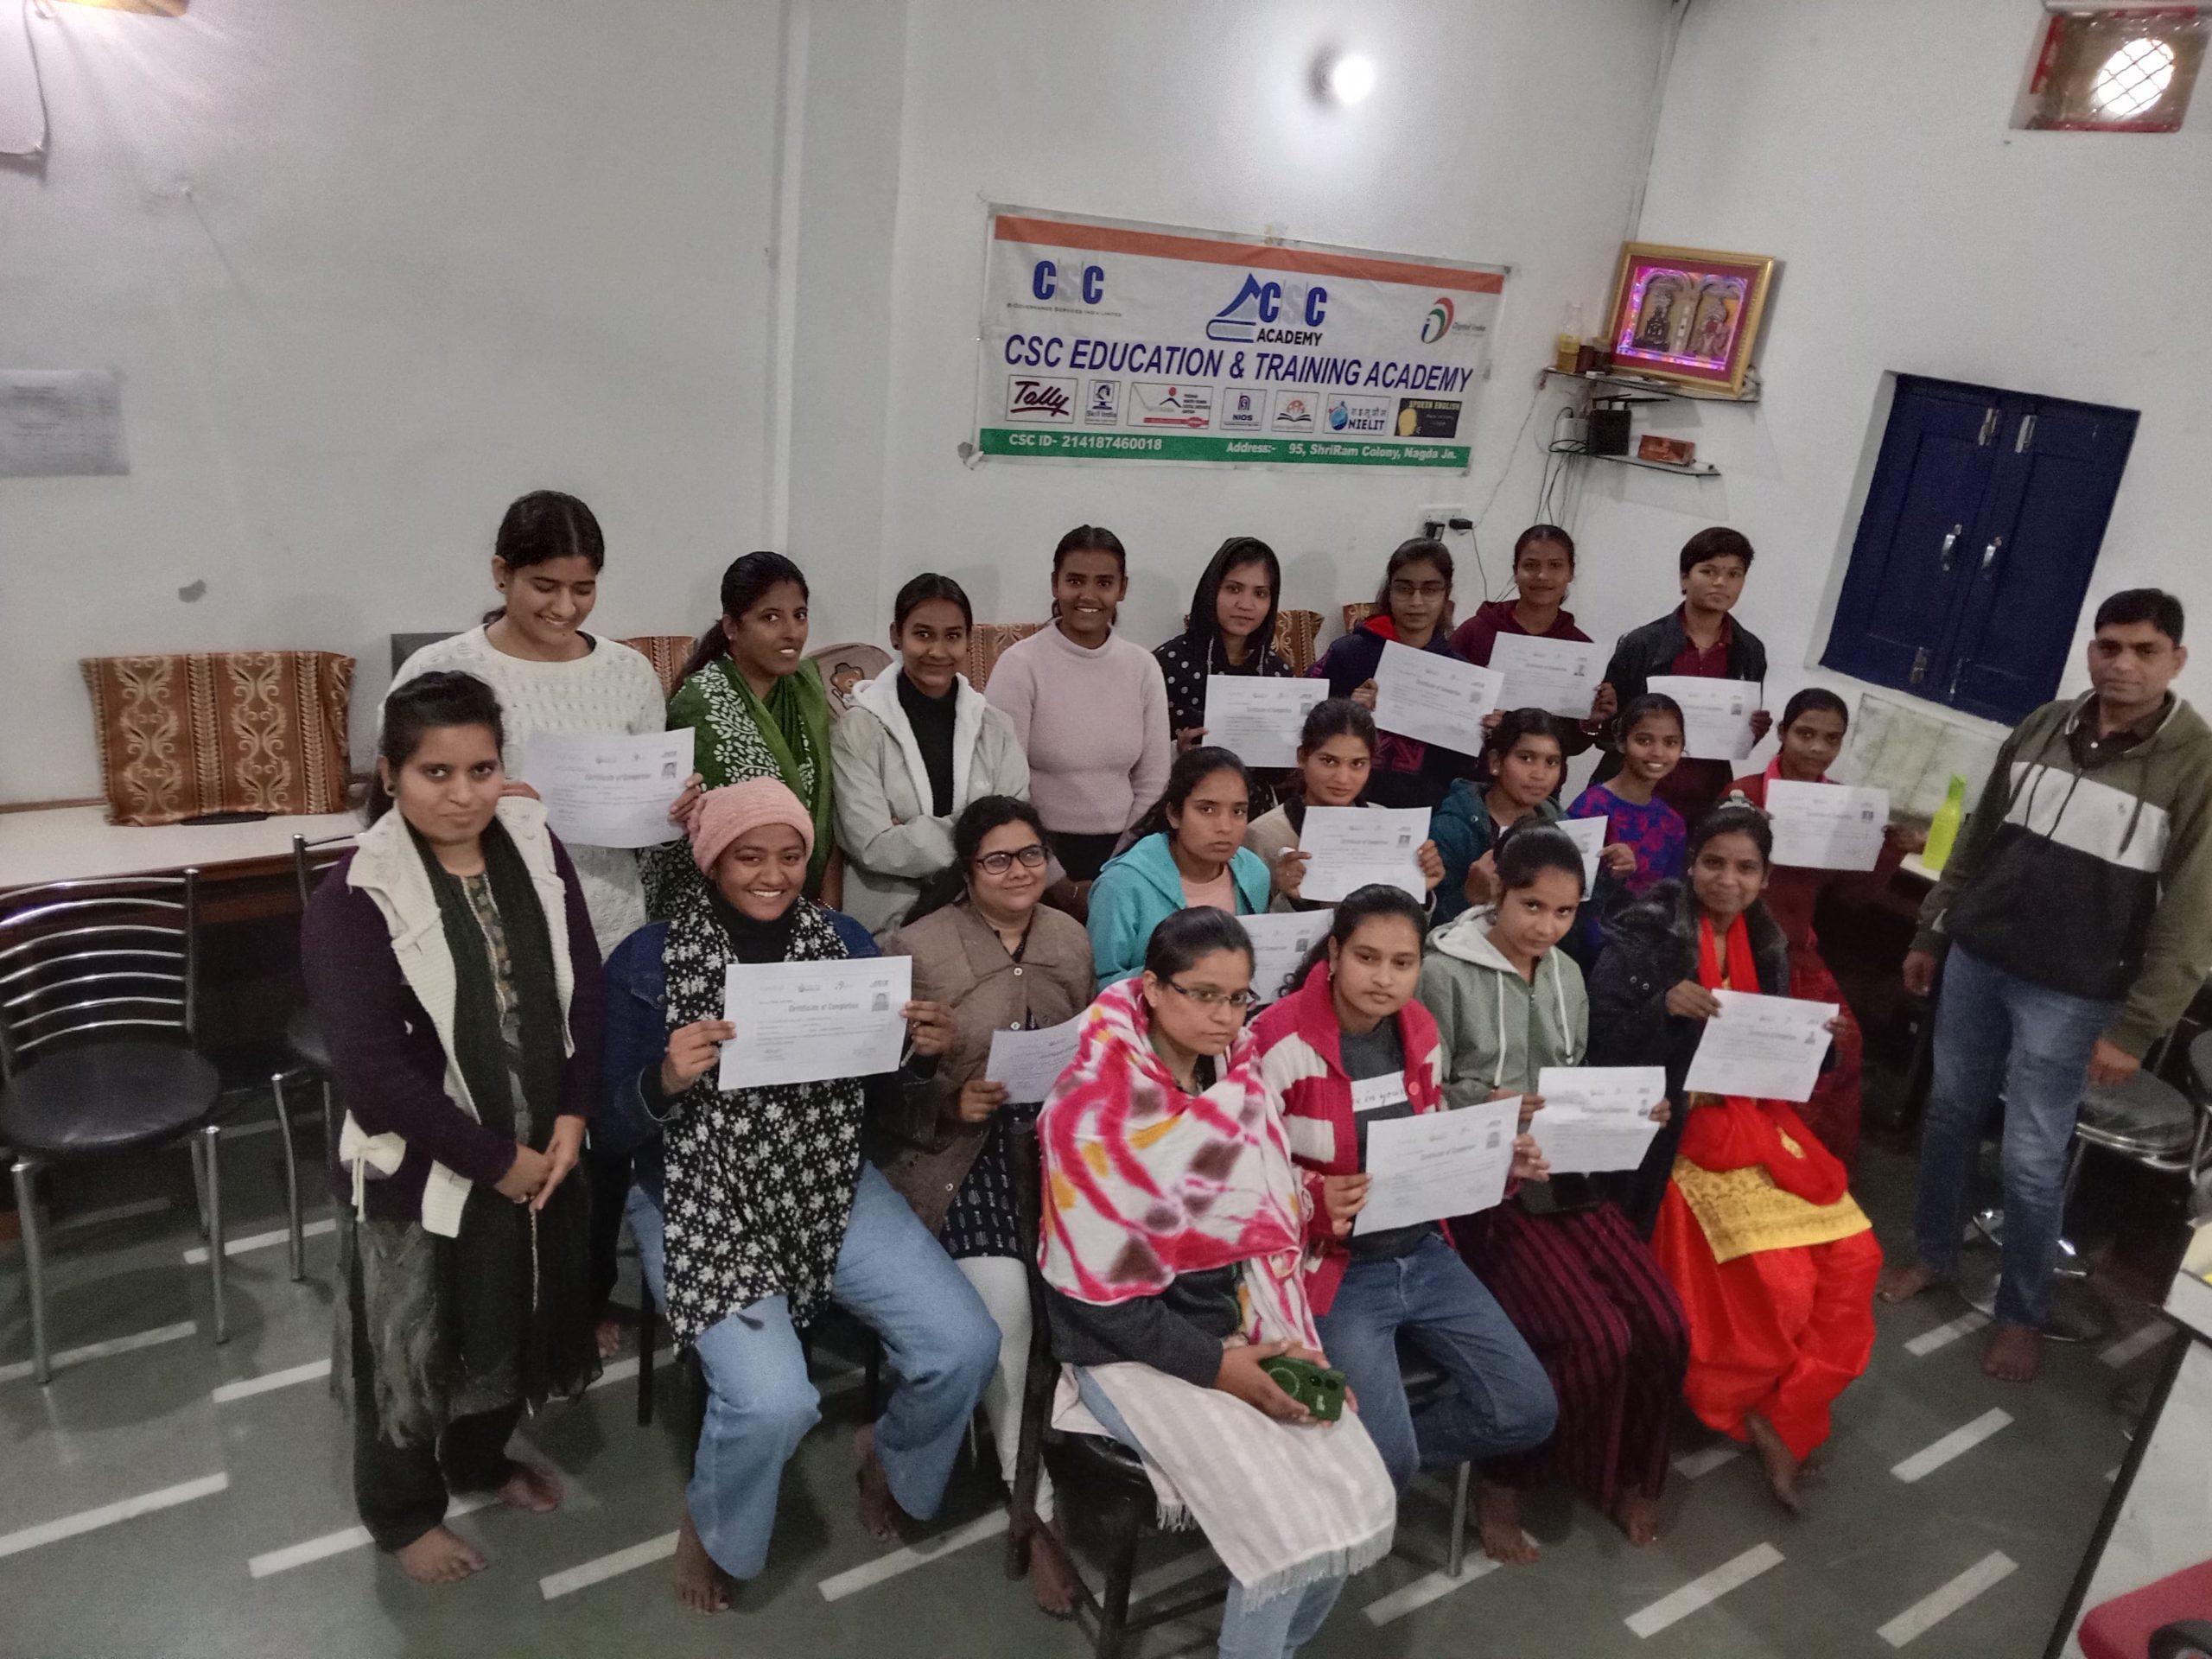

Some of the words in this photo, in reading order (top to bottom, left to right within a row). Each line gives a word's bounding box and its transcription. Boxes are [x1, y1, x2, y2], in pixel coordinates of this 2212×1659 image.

[1033, 260, 1104, 305] CSC
[1258, 282, 1328, 327] CSC
[1256, 328, 1323, 346] ACADEMY
[1004, 334, 1064, 368] CSC
[1069, 339, 1224, 378] EDUCATION
[1229, 350, 1246, 380] &
[1255, 352, 1362, 386] TRAINING
[1363, 360, 1474, 393] ACADEMY
[1014, 380, 1070, 416] Tally
[1348, 419, 1385, 431] NIELIT
[1008, 434, 1036, 446] CSC
[1039, 435, 1058, 447] ID-
[1061, 435, 1162, 450] 214187460018
[1225, 441, 1276, 454] Address:-
[1287, 443, 1306, 457] 95,
[1309, 444, 1359, 457] ShriRam
[1362, 445, 1402, 460] Colony,
[1404, 447, 1438, 461] Nagda
[1440, 448, 1458, 460] Jn.
